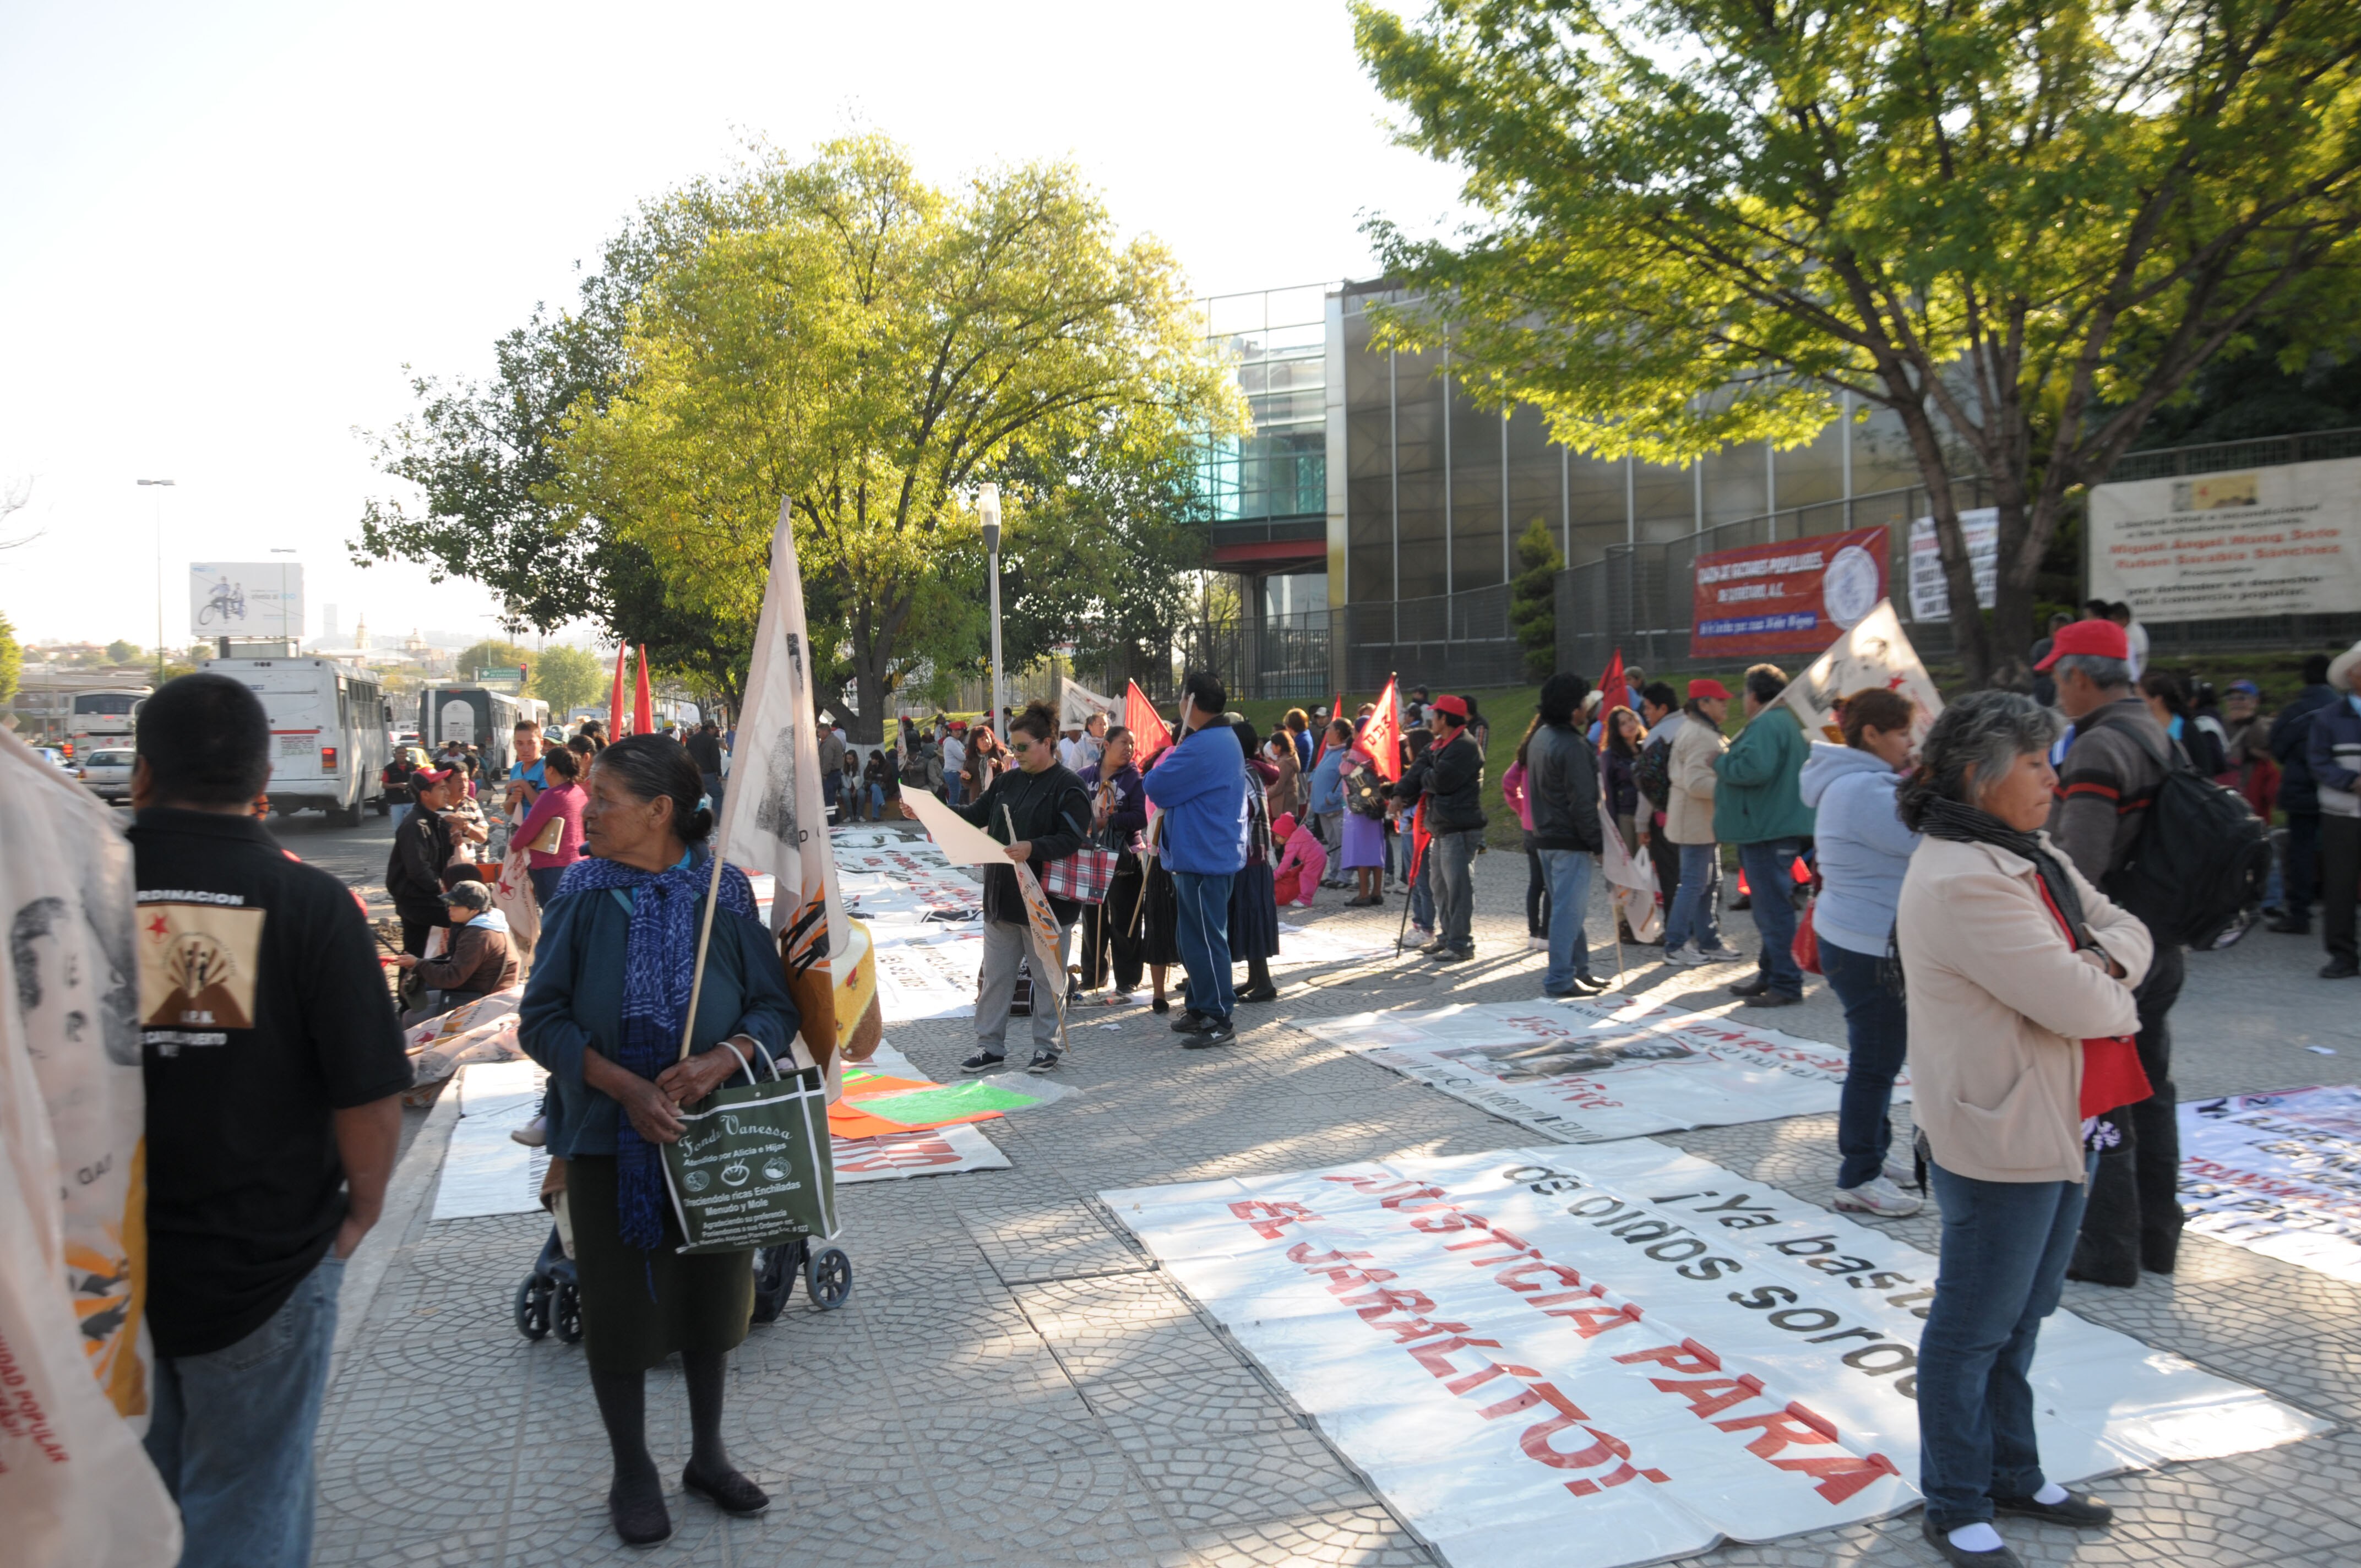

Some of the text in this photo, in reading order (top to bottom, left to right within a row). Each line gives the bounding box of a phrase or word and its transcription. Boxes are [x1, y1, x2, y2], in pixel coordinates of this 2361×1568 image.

[720, 1115, 793, 1140] Vanessa
[733, 1148, 757, 1157] Alicia
[765, 1142, 787, 1153] Hijas
[732, 1190, 753, 1200] ricas
[754, 1181, 802, 1196] Enchiladas
[705, 1199, 769, 1216] Menudo y Mole
[1611, 1337, 1901, 1505] PARA
